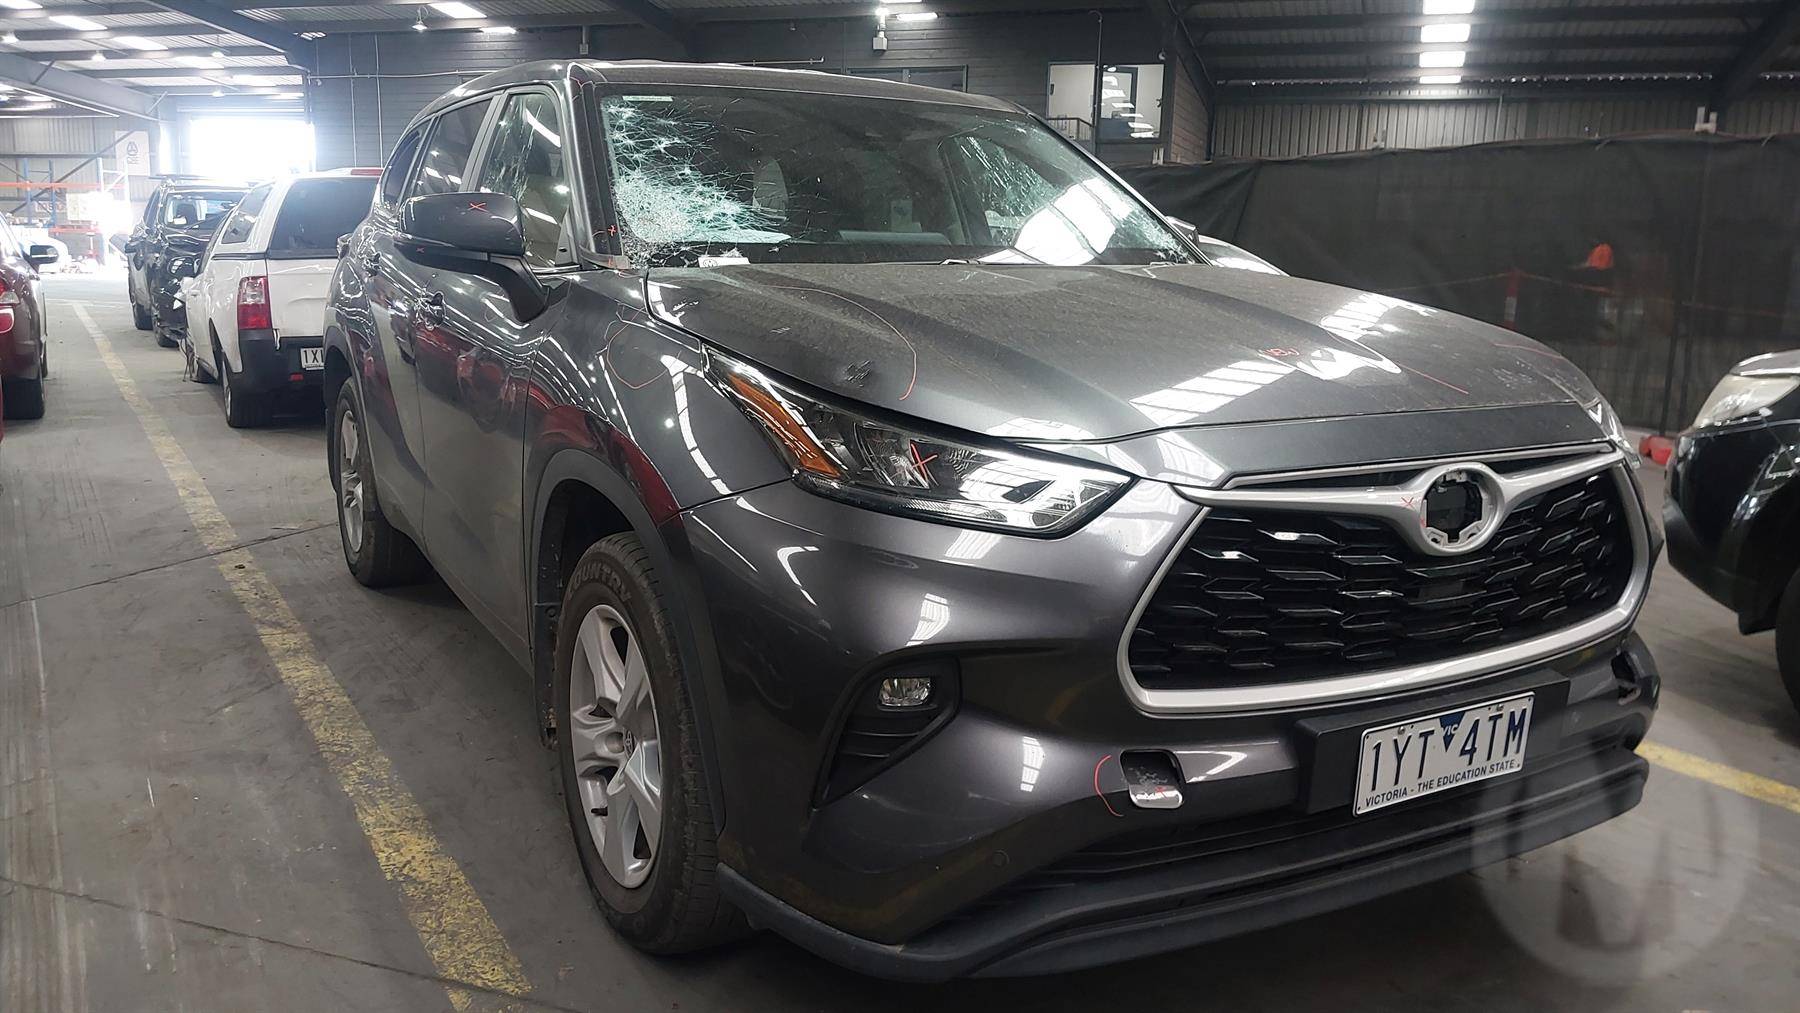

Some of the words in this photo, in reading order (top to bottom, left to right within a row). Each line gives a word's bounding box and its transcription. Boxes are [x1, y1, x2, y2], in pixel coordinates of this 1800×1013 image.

[1371, 730, 1434, 791] 1YT
[1459, 707, 1527, 766] 4TM
[1443, 723, 1458, 737] VIC
[1366, 787, 1407, 807] VICTORIA
[1417, 780, 1434, 792] THE
[1437, 765, 1487, 786] EDUCATION
[1489, 759, 1515, 773] STATE
